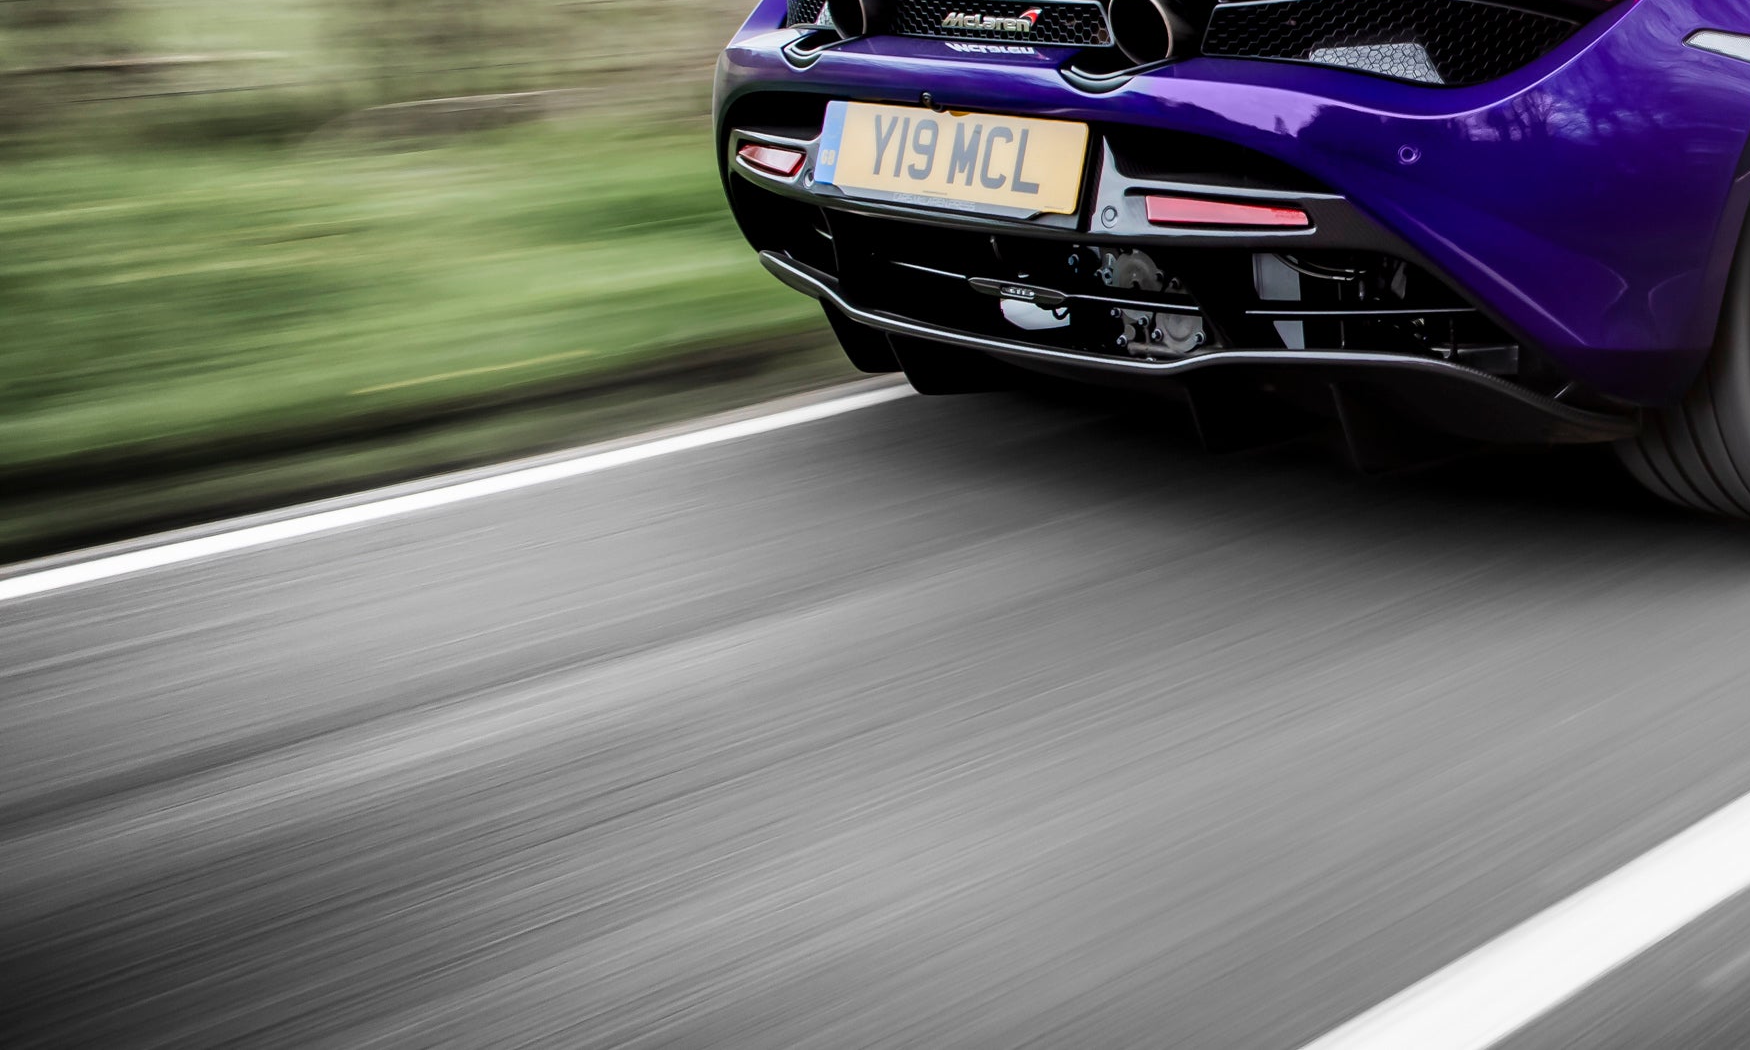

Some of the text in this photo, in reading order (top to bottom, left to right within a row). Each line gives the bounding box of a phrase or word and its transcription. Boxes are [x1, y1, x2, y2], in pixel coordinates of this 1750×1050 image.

[941, 11, 1031, 33] McLaren
[873, 114, 1039, 194] Y19 MCL
